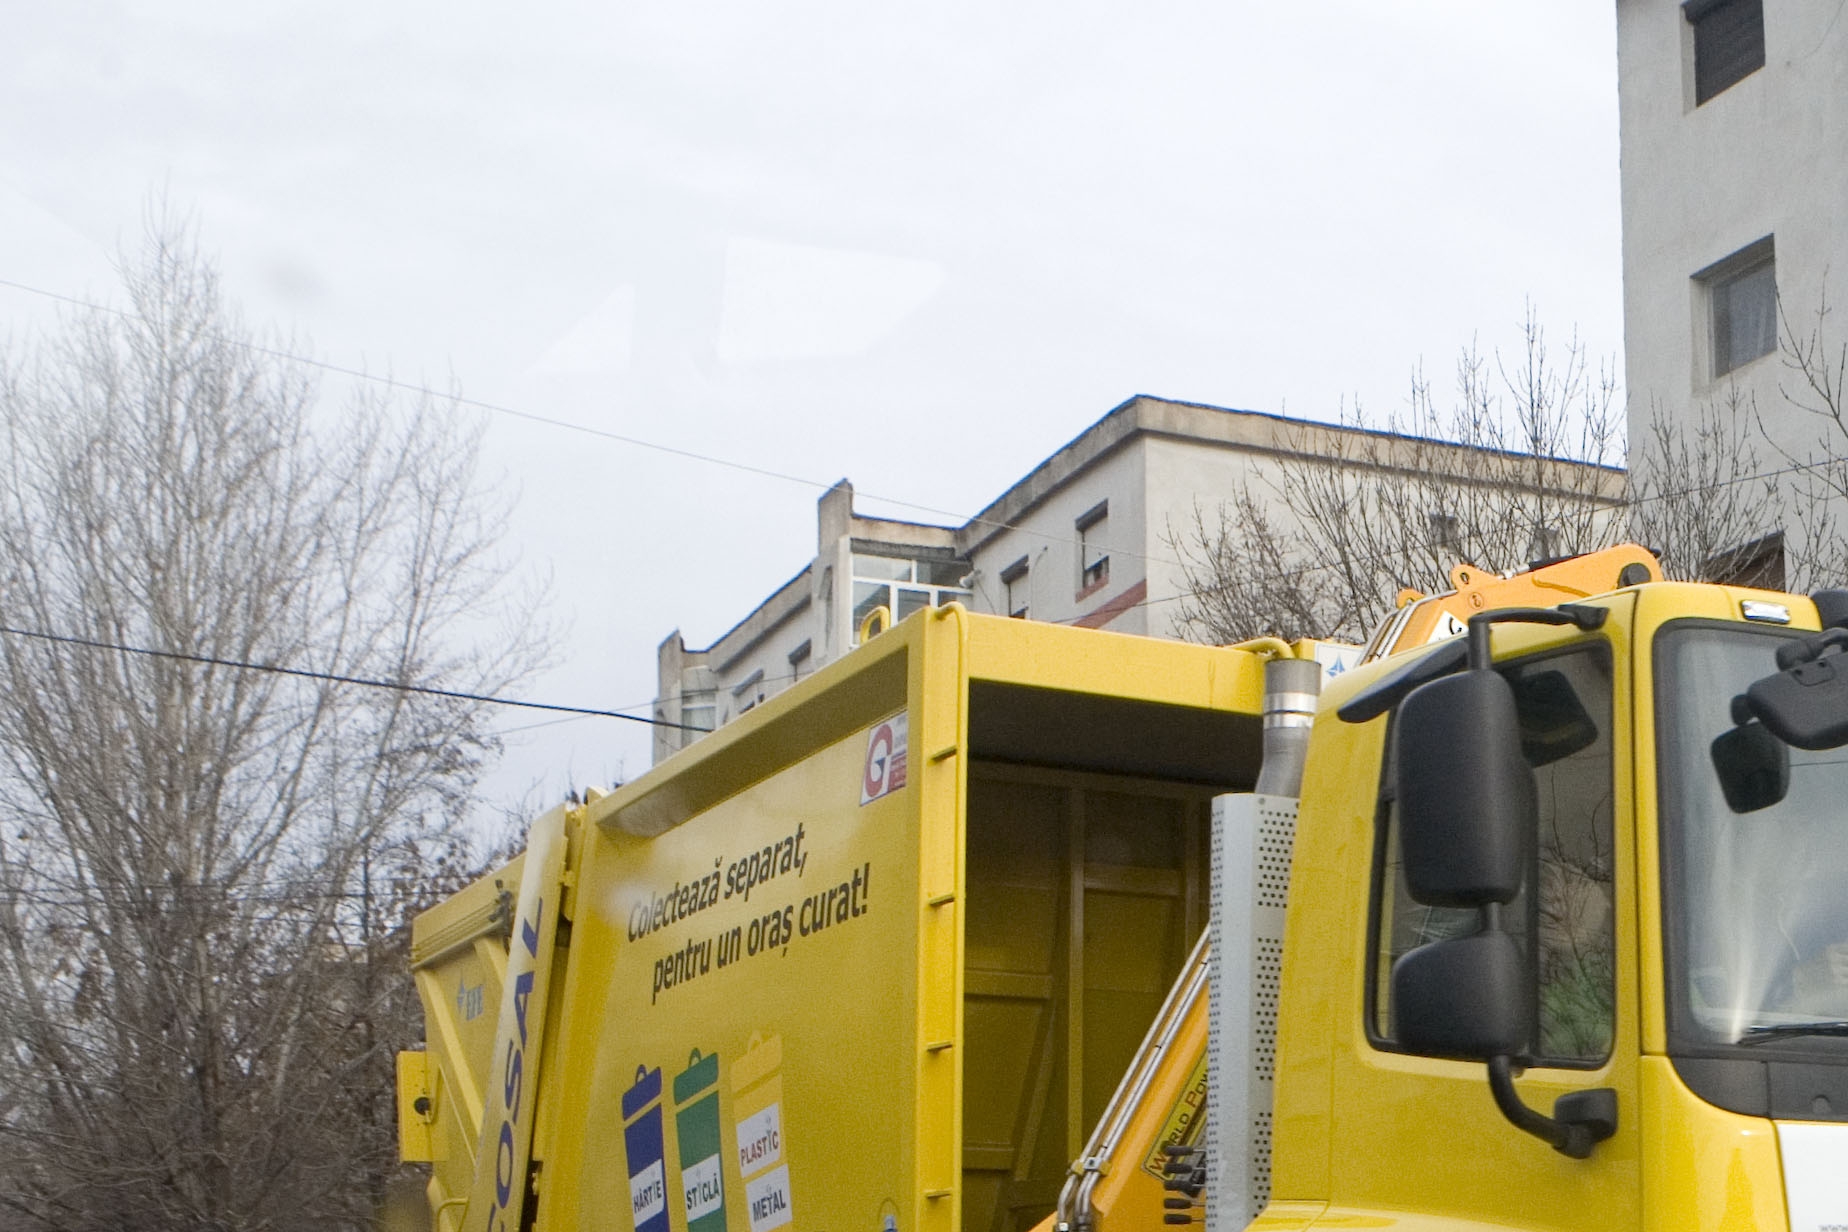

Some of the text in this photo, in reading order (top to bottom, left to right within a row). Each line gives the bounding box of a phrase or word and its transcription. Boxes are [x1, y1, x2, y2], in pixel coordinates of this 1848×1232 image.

[628, 822, 808, 943] Colectează separat,
[652, 862, 871, 1006] pentru un oraș curat!
[740, 1129, 779, 1167] PLASTIC
[1150, 1113, 1190, 1171] WRLD
[752, 1189, 787, 1223] METAL
